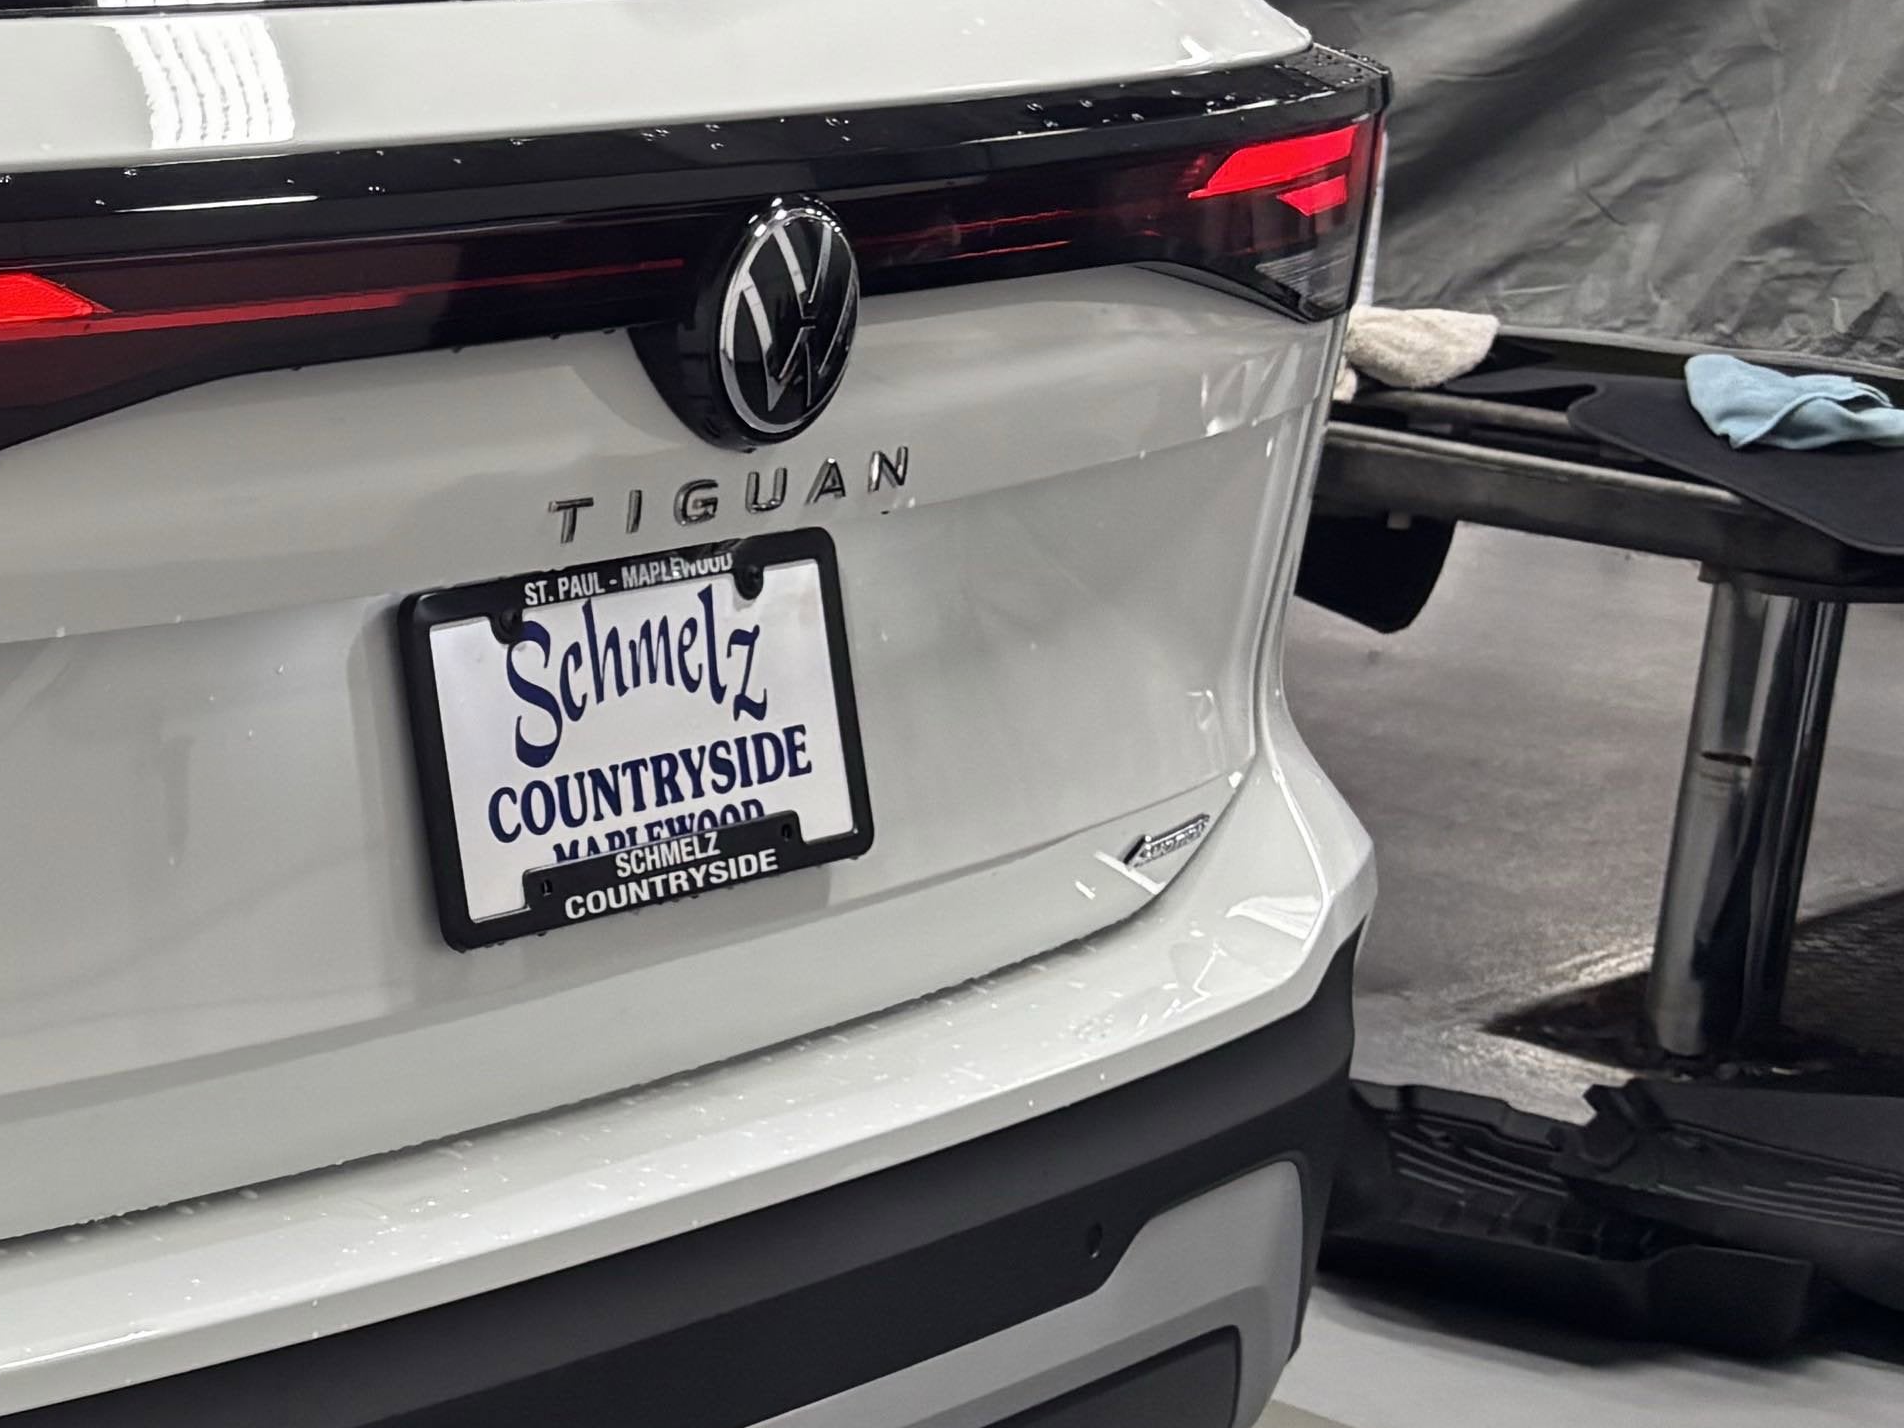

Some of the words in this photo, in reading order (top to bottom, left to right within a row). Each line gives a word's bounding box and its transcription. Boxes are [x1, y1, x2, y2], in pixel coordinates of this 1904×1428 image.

[549, 446, 908, 544] TIGUAN
[524, 581, 555, 606] ST.
[559, 572, 605, 599] PAUL
[506, 584, 767, 768] Schmelz
[489, 725, 812, 843] COUNTRYSIDE
[565, 848, 779, 920] COUNTRYSIDE
[615, 831, 721, 878] SCHMELZ
